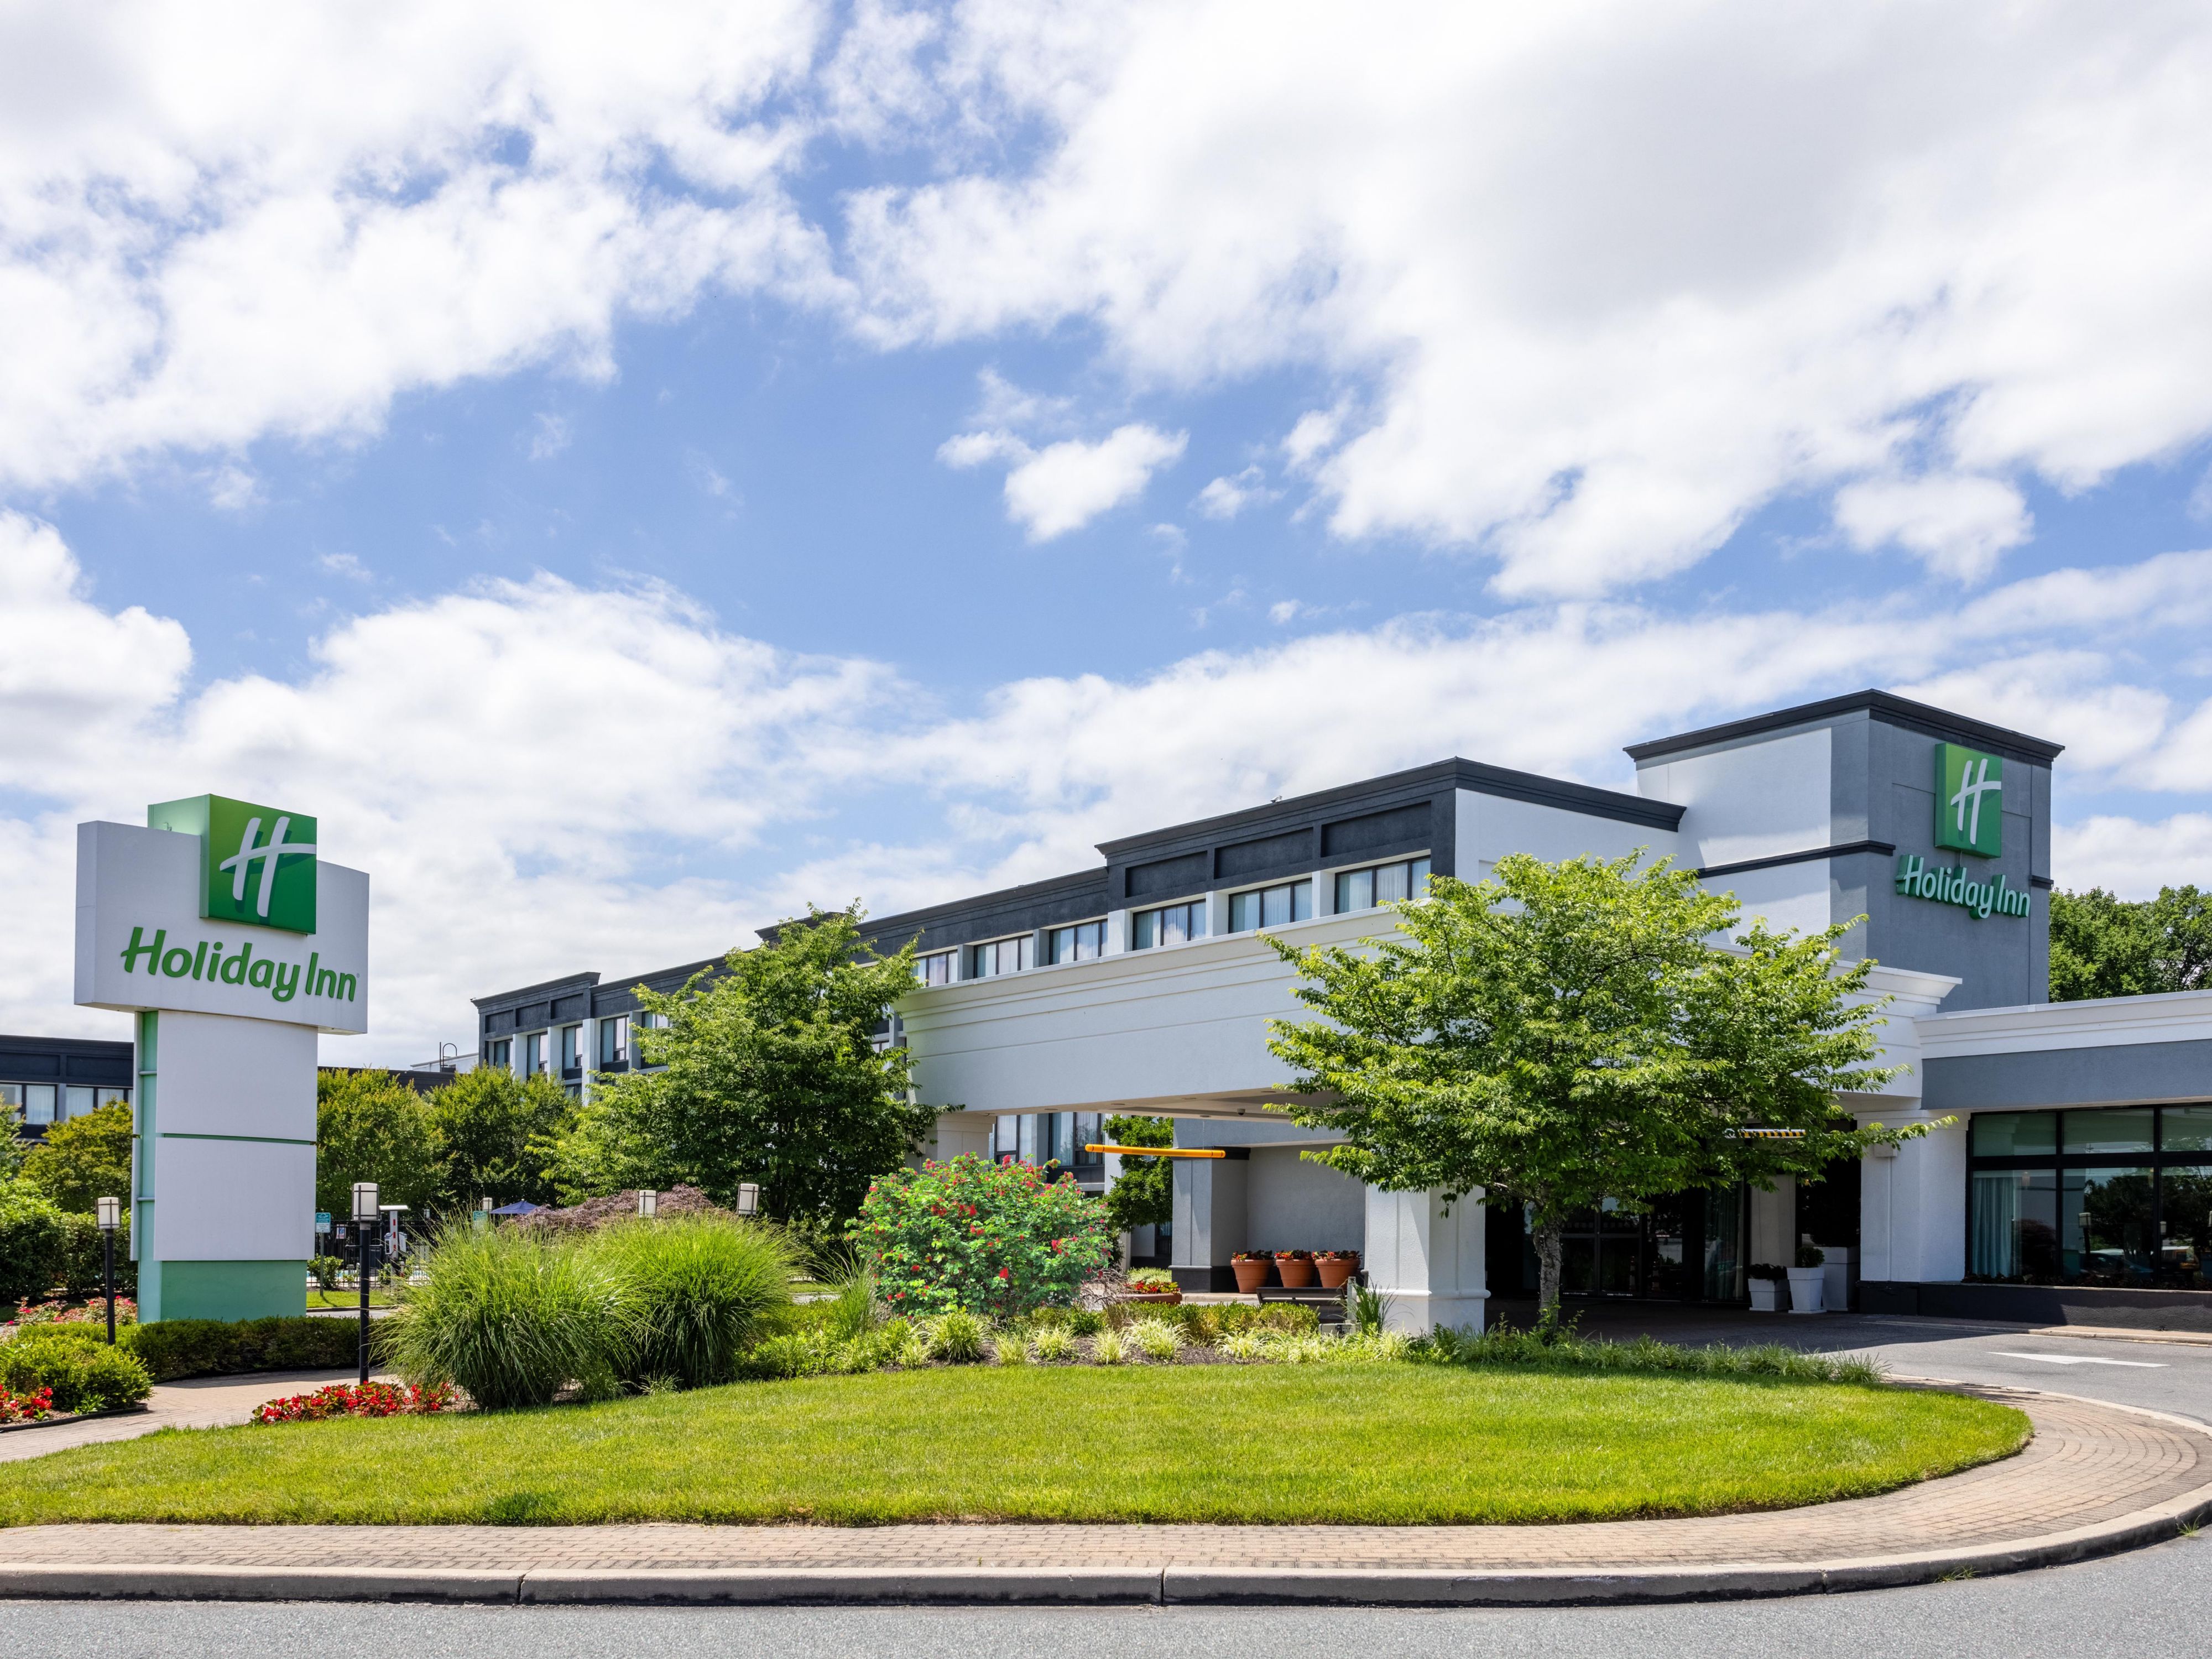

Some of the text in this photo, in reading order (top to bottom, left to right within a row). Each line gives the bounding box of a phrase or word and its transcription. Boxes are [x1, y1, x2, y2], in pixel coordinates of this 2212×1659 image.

[1901, 854, 2031, 919] Holiday Inn
[121, 927, 357, 1002] Holiday Inn
